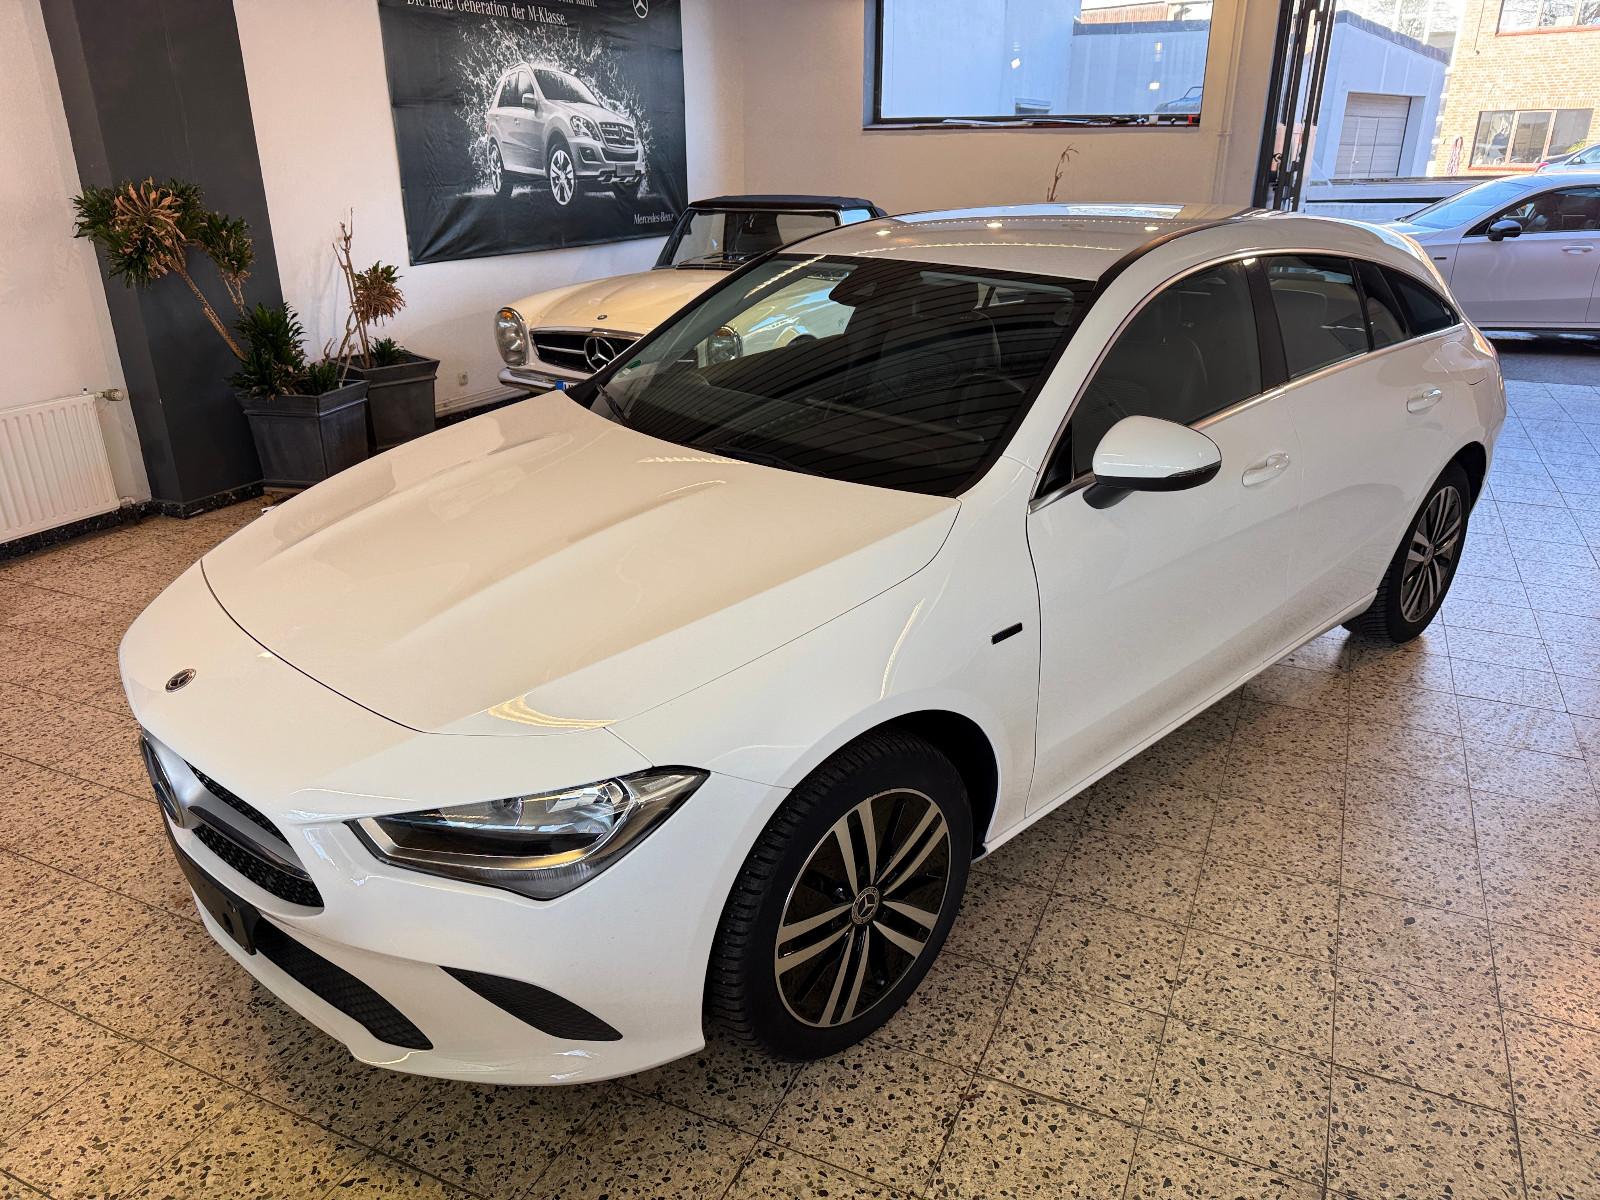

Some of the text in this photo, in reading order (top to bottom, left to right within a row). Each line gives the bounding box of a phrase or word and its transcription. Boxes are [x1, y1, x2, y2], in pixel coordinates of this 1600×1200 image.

[456, 0, 510, 18] Generation
[510, 2, 525, 20] der
[527, 5, 568, 26] M-Klasse.
